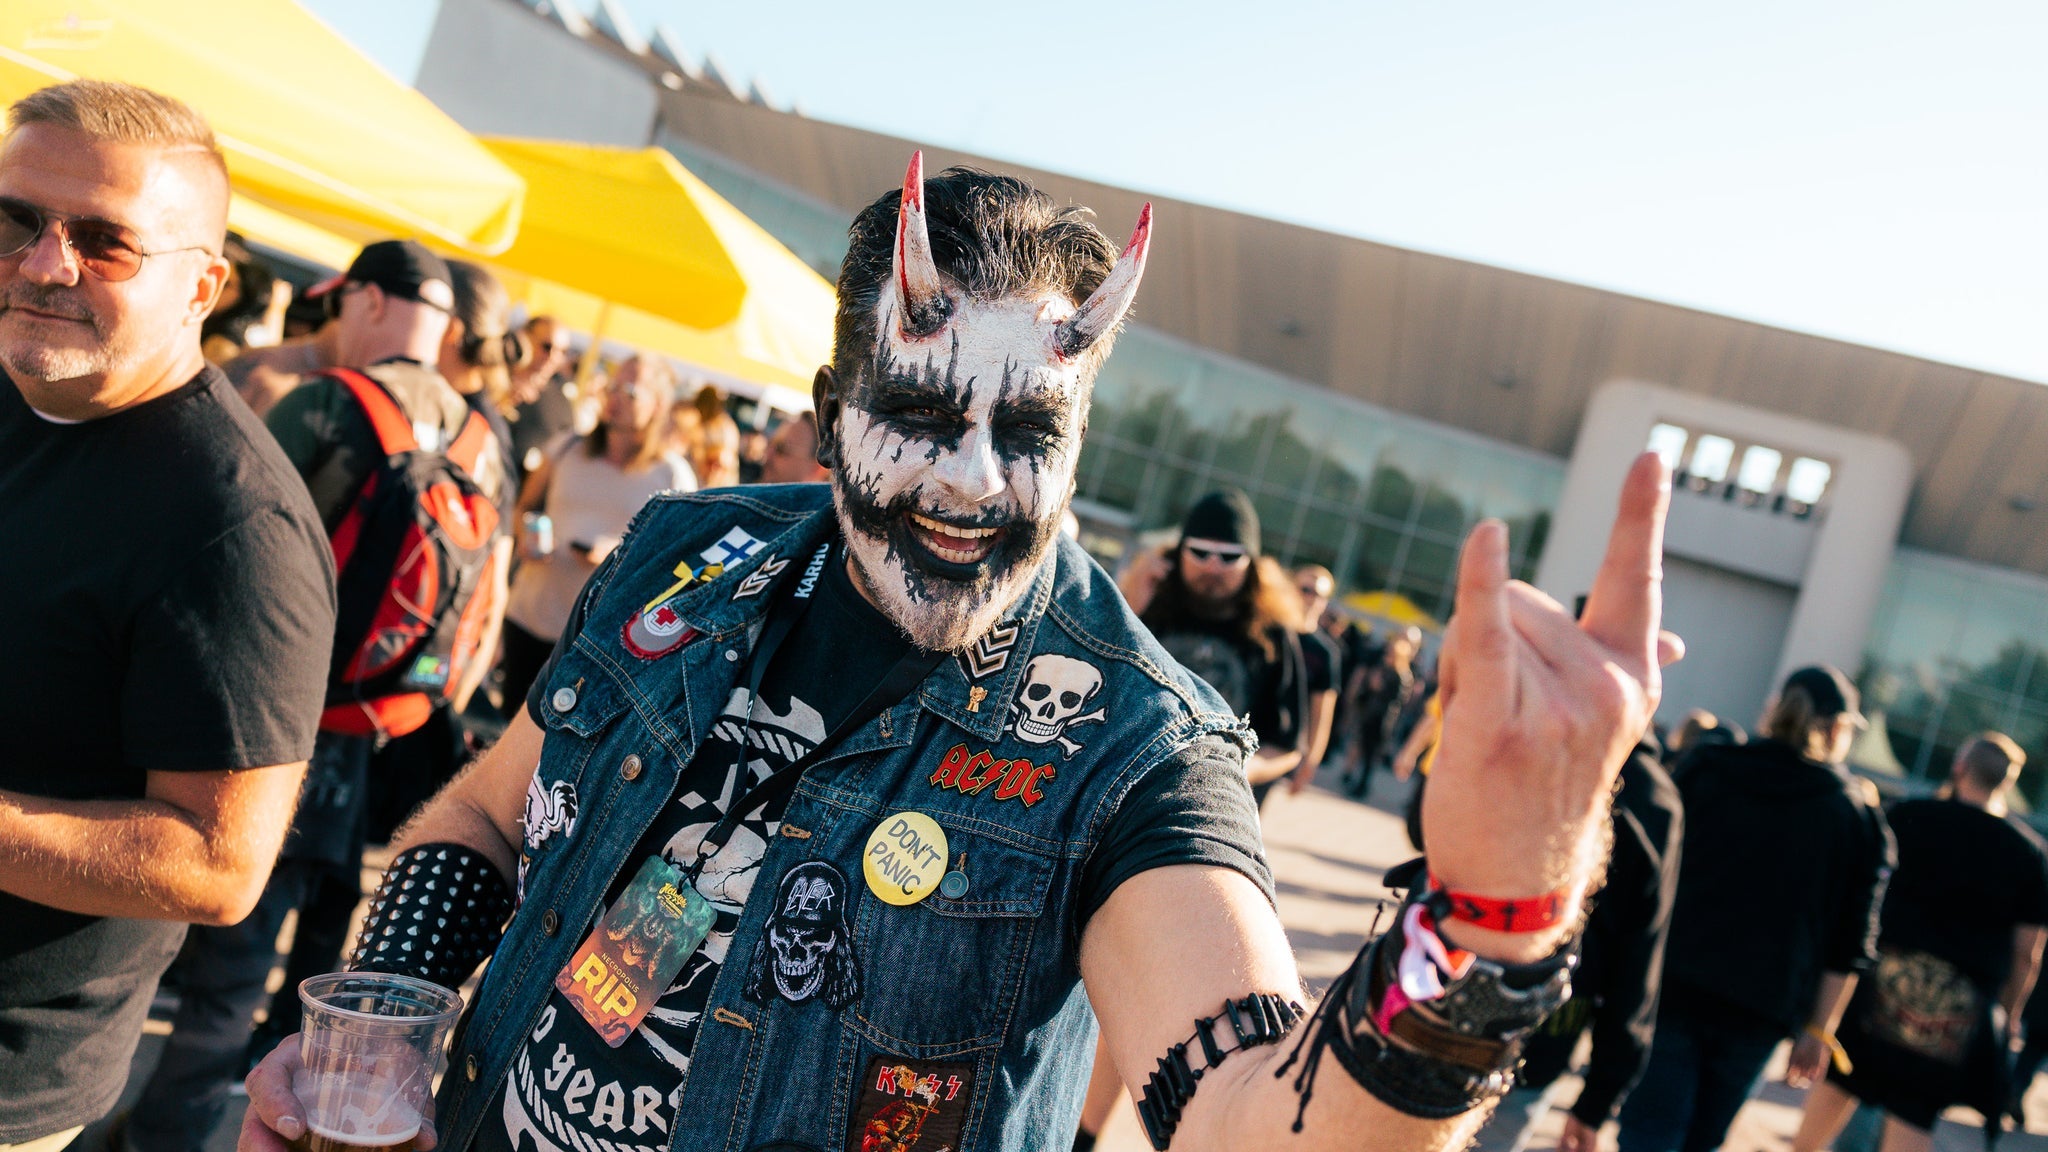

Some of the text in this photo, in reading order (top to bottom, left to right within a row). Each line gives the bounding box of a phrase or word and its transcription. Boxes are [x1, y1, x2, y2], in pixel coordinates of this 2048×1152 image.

[794, 543, 829, 598] KARHU
[868, 841, 921, 895] PANIC
[887, 819, 941, 869] DON'T
[572, 951, 638, 1018] RIP
[601, 953, 640, 993] NECROPOLIS
